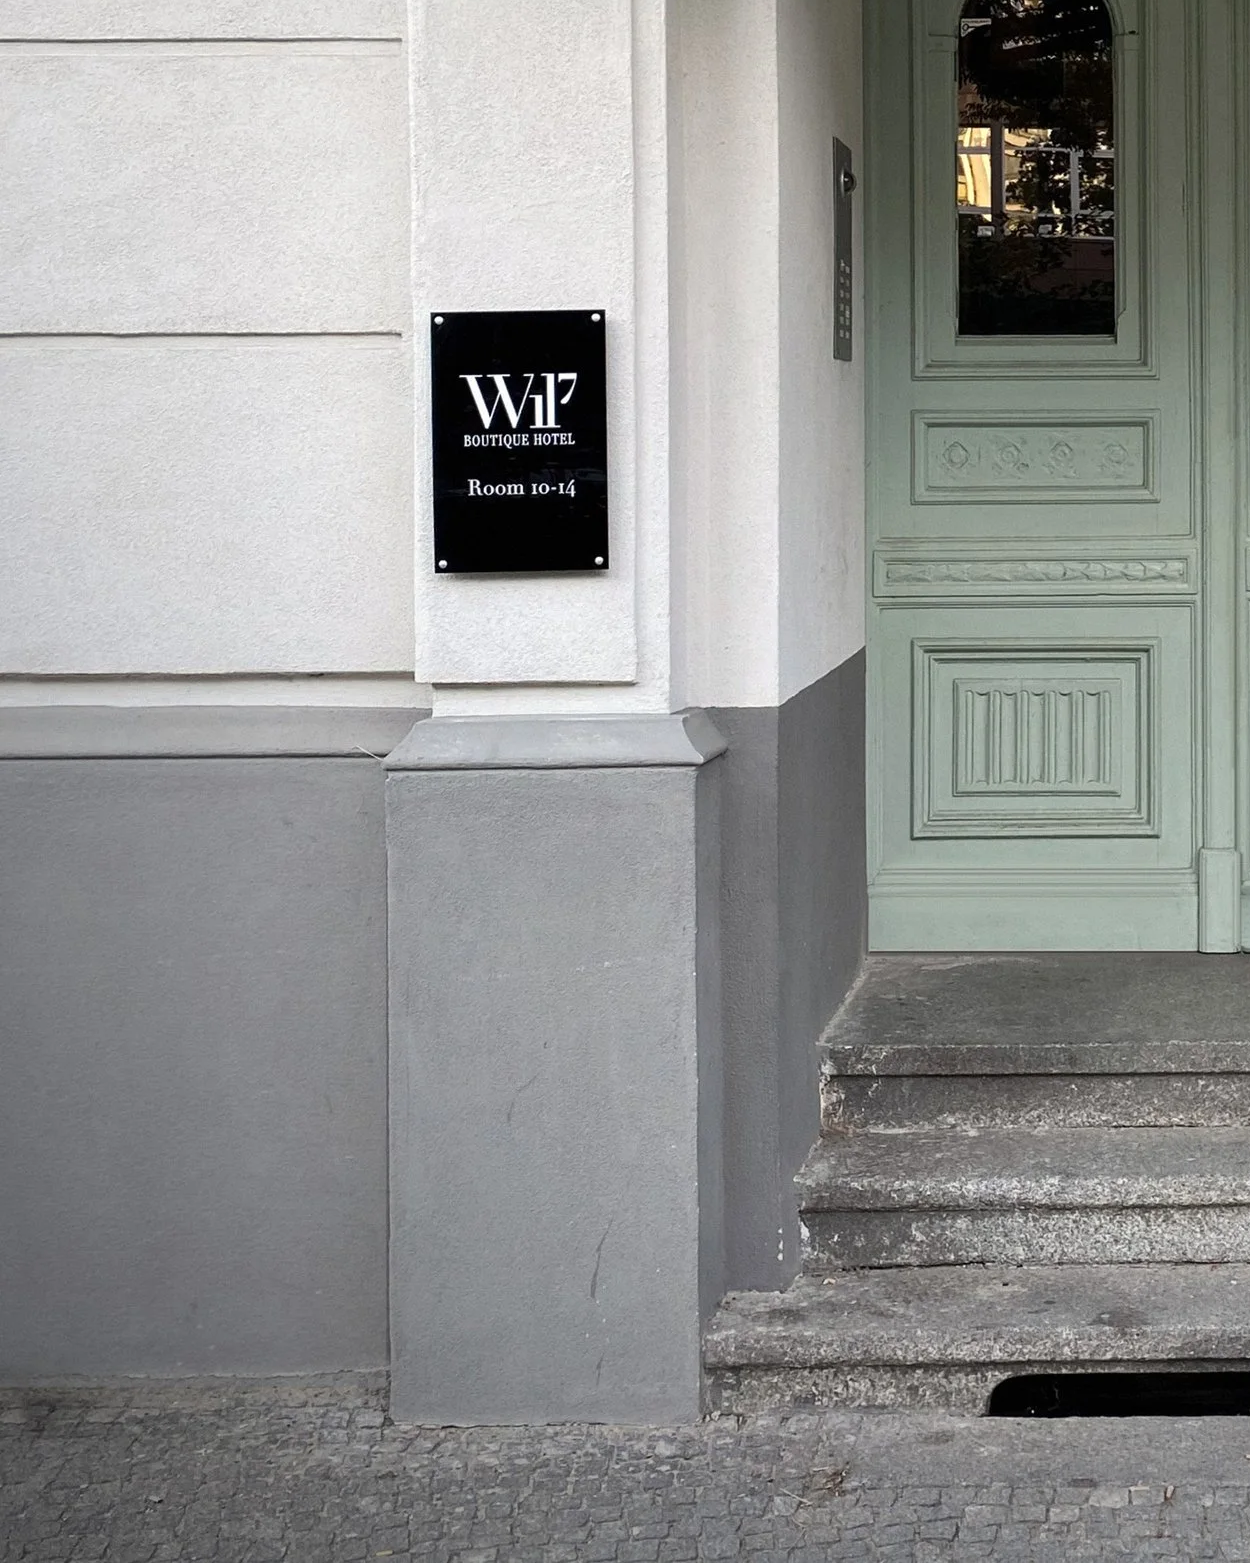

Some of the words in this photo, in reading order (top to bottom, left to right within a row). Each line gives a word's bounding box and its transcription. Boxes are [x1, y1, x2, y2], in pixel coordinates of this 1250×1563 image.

[463, 434, 529, 449] BOUTIQUE
[533, 433, 575, 446] HOTEL
[467, 479, 525, 496] Room
[531, 479, 576, 498] 10-14
